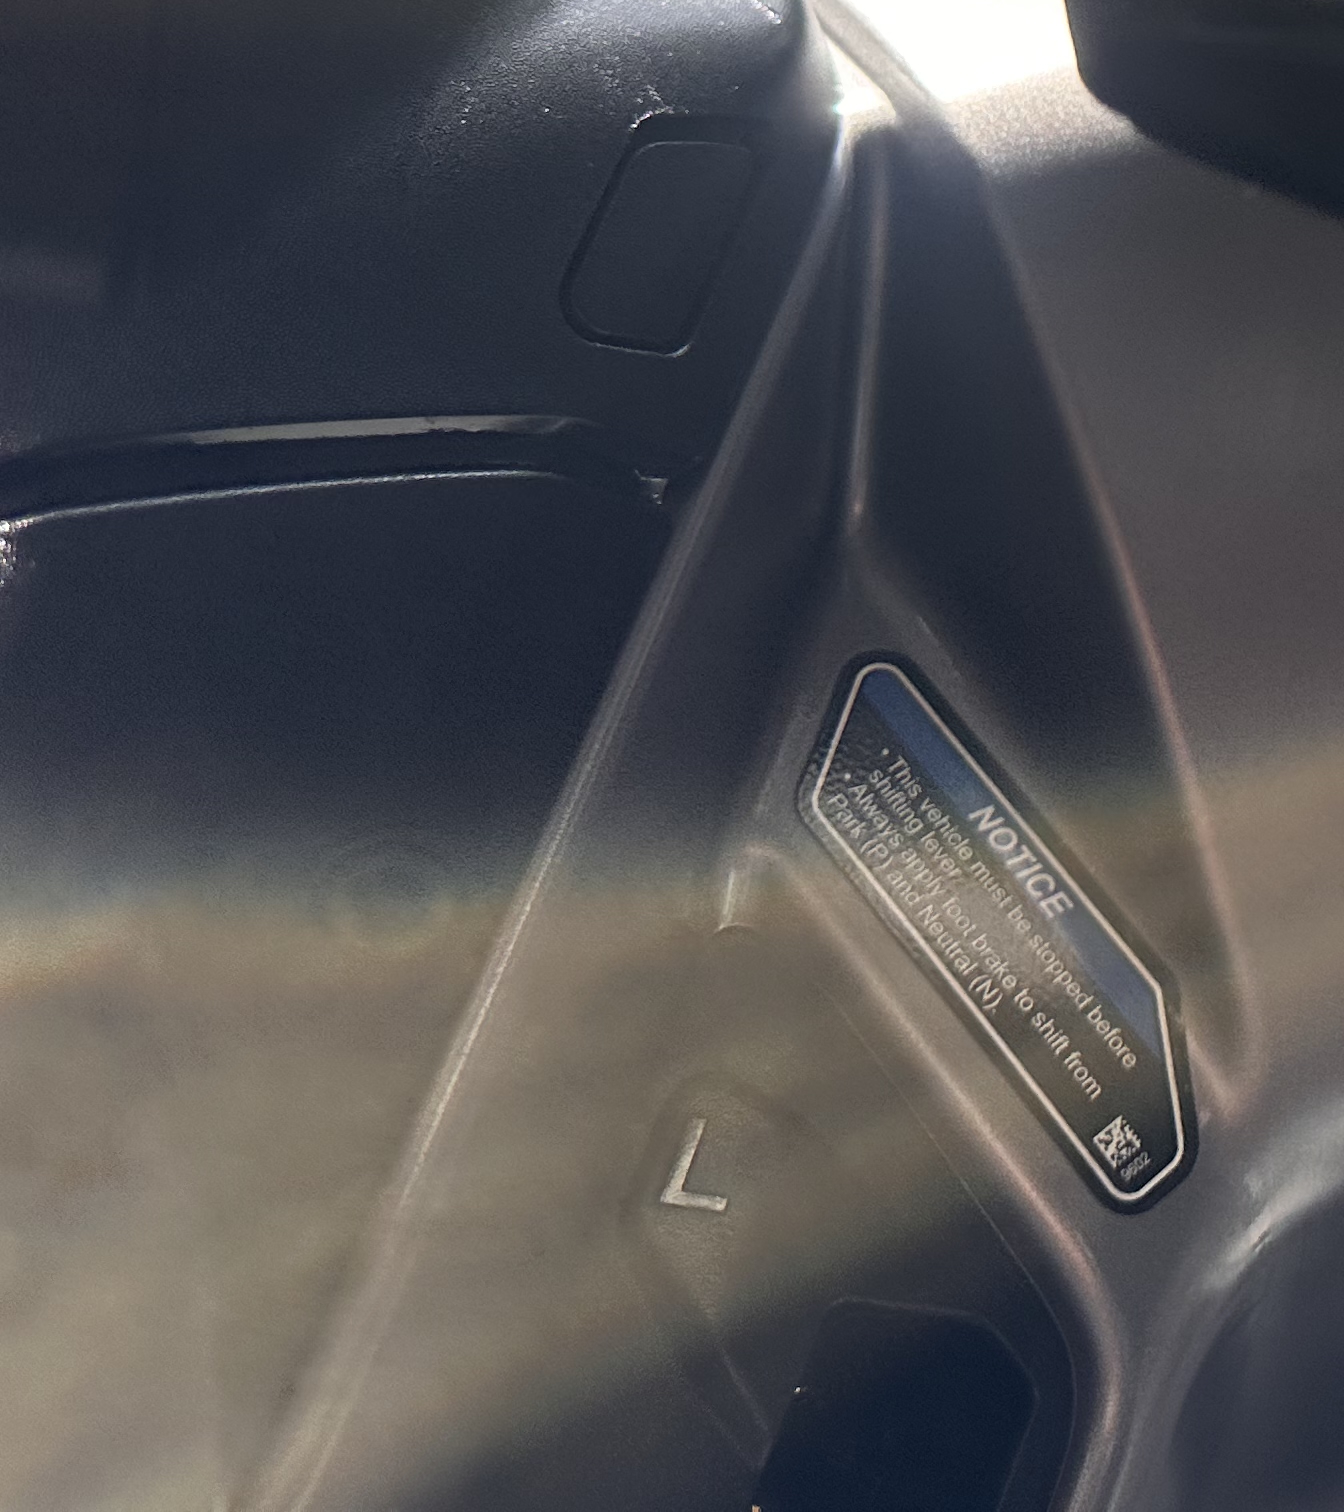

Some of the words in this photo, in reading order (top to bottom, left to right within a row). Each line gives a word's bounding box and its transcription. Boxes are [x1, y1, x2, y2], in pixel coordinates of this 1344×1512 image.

[868, 768, 924, 835] shifting
[967, 804, 1074, 918] NOTICE
[826, 792, 866, 838] Park
[859, 837, 894, 871] (P)
[885, 869, 925, 907] and
[916, 903, 978, 975] Neutral
[847, 783, 903, 847] Always
[900, 847, 946, 898] apply
[941, 895, 977, 937] foot
[970, 932, 1017, 990] brake
[1013, 987, 1034, 1011] to
[1030, 1011, 1069, 1055] shift
[1063, 1050, 1101, 1100] from
[887, 754, 922, 798] This
[919, 796, 973, 860] vehicle
[968, 860, 1012, 908] must
[1006, 903, 1031, 934] be
[1028, 934, 1094, 1010] stopped
[1085, 1003, 1136, 1068] before
[660, 1118, 728, 1211] L
